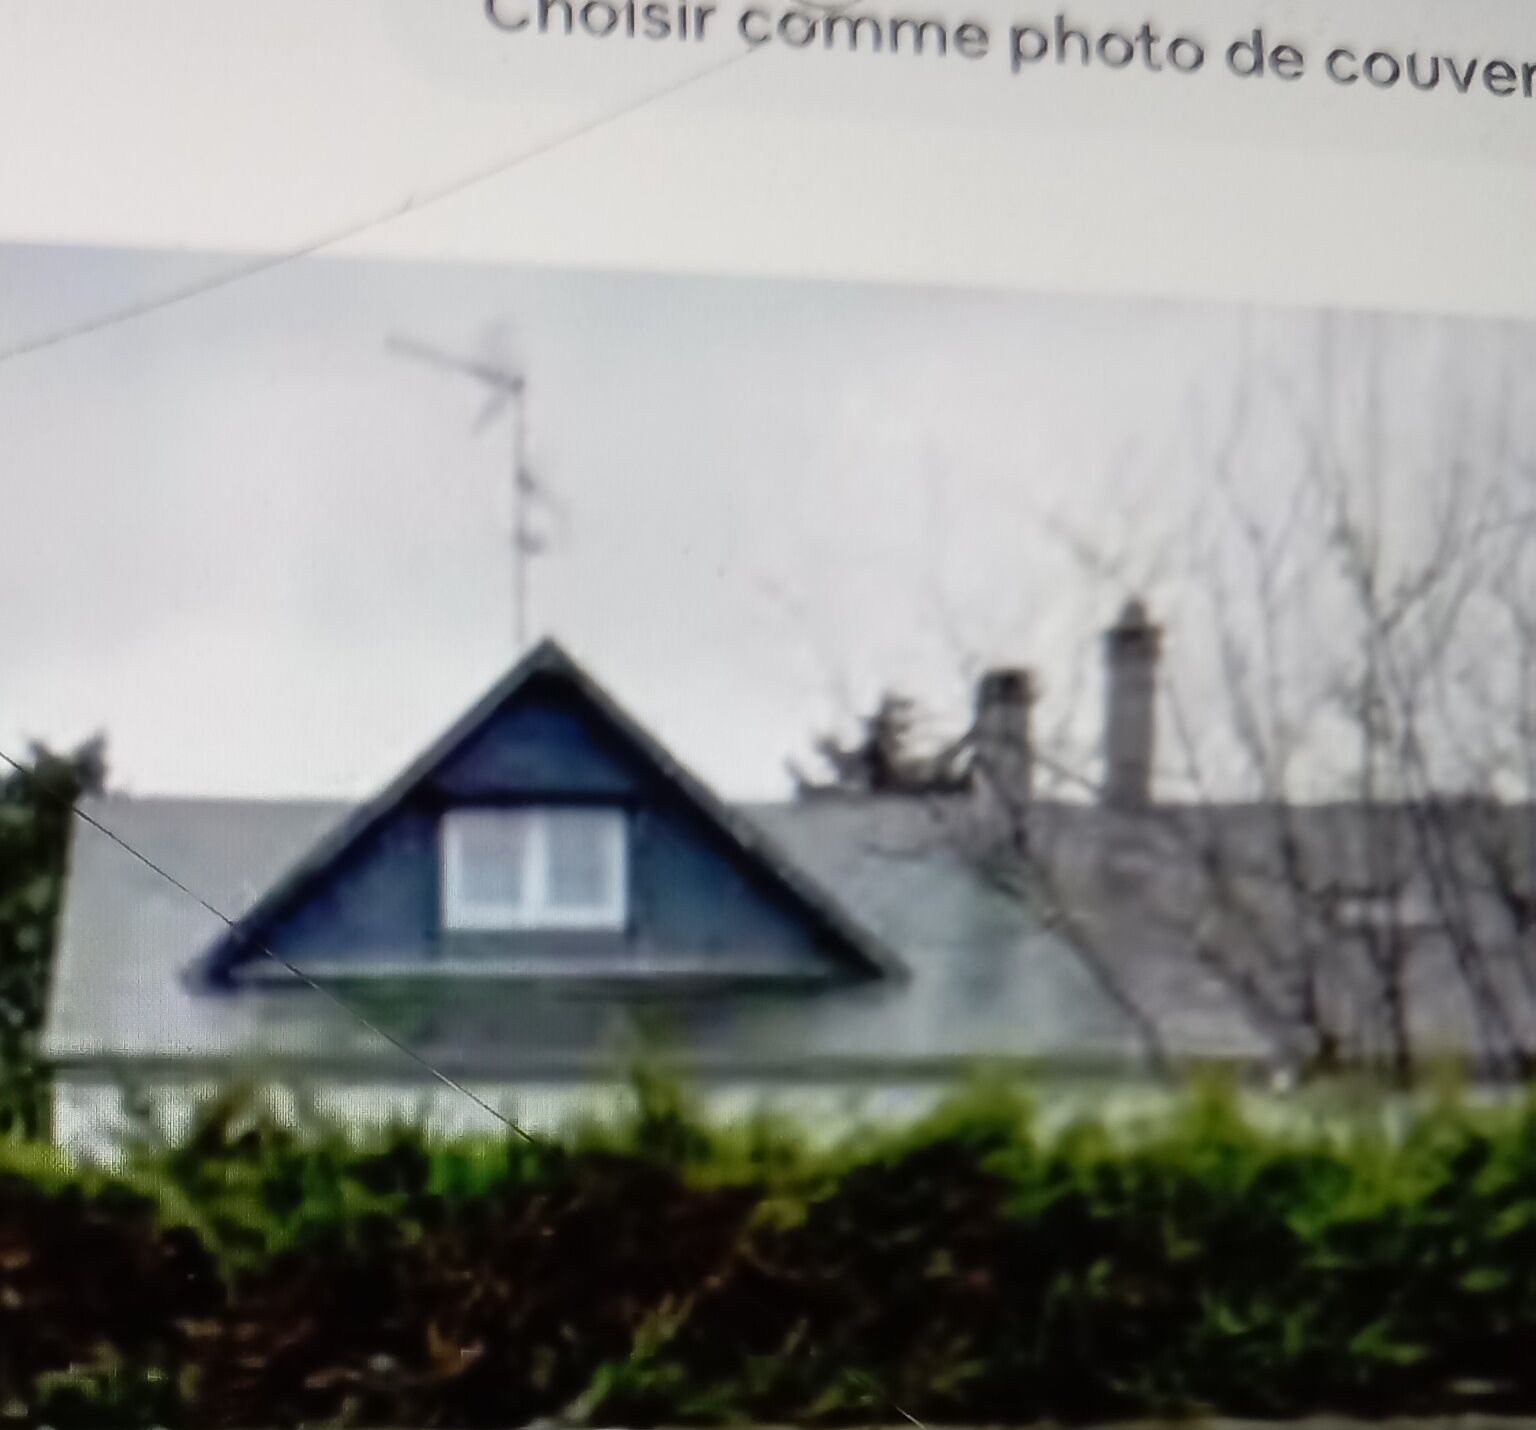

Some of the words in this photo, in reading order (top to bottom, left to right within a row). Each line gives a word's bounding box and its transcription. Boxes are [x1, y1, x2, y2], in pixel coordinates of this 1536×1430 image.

[738, 9, 989, 60] comme
[1009, 13, 1205, 75] photo
[1226, 28, 1305, 81] de
